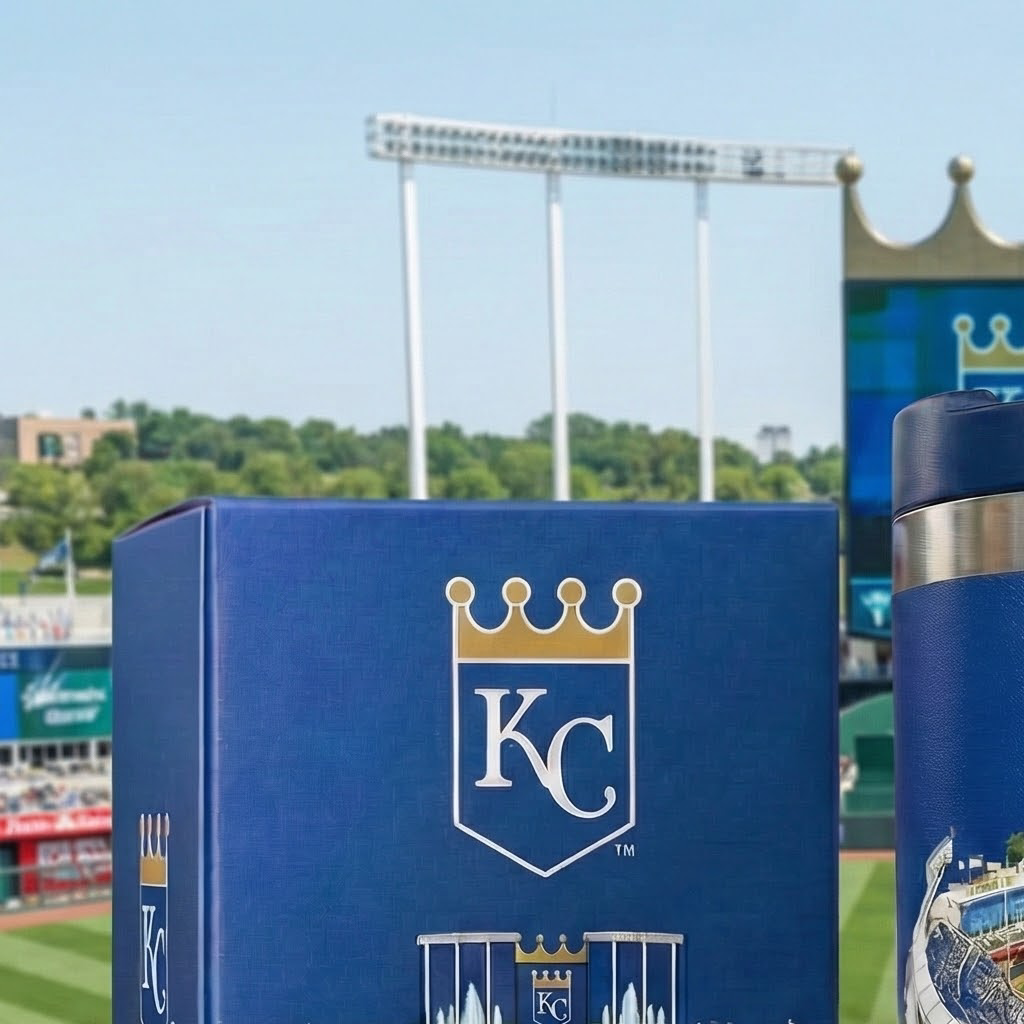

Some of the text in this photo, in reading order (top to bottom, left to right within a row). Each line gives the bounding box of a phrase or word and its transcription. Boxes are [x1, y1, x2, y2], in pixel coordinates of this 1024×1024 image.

[474, 688, 617, 819] KC
[614, 843, 636, 857] TM
[141, 904, 166, 1015] KC
[536, 991, 569, 1021] KC
